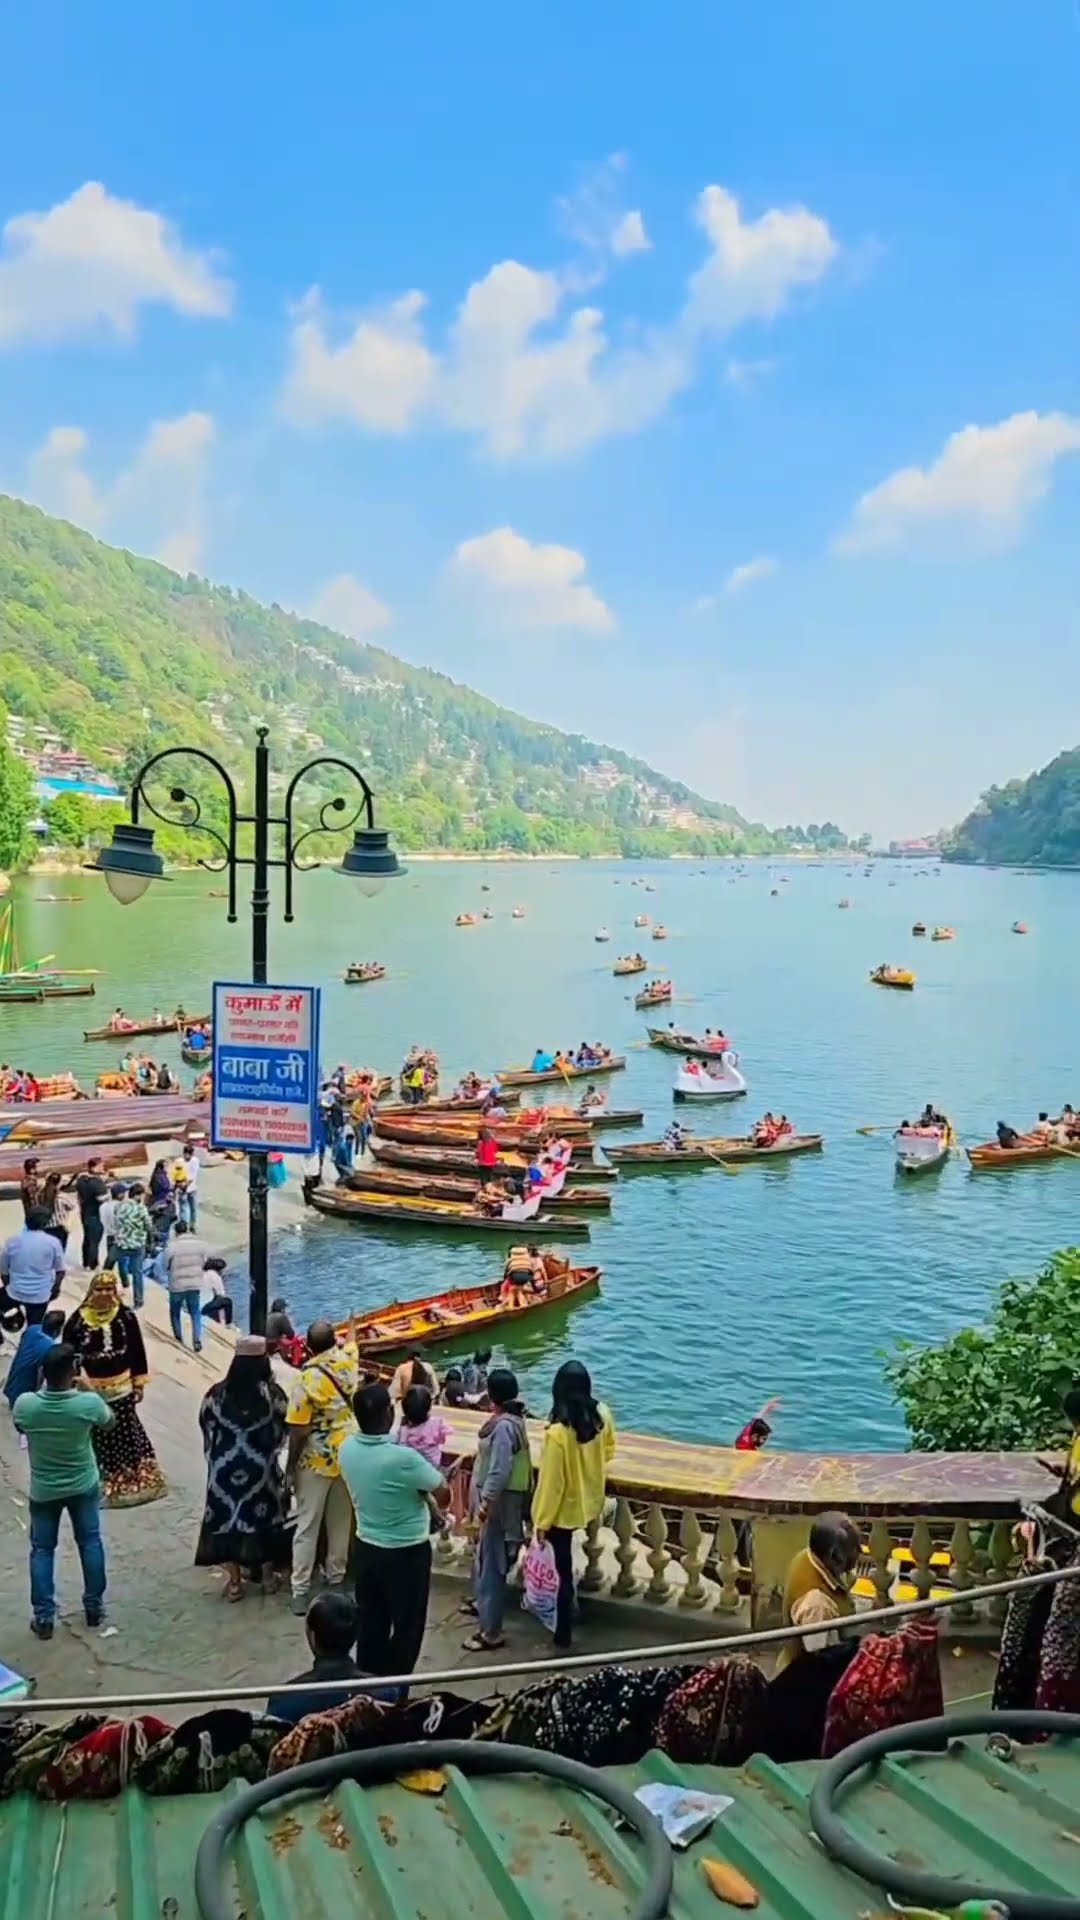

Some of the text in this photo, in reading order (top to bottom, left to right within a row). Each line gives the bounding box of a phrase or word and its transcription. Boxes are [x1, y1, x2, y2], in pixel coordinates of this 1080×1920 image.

[286, 994, 303, 1013] में
[221, 1053, 306, 1082] बाबा जी
